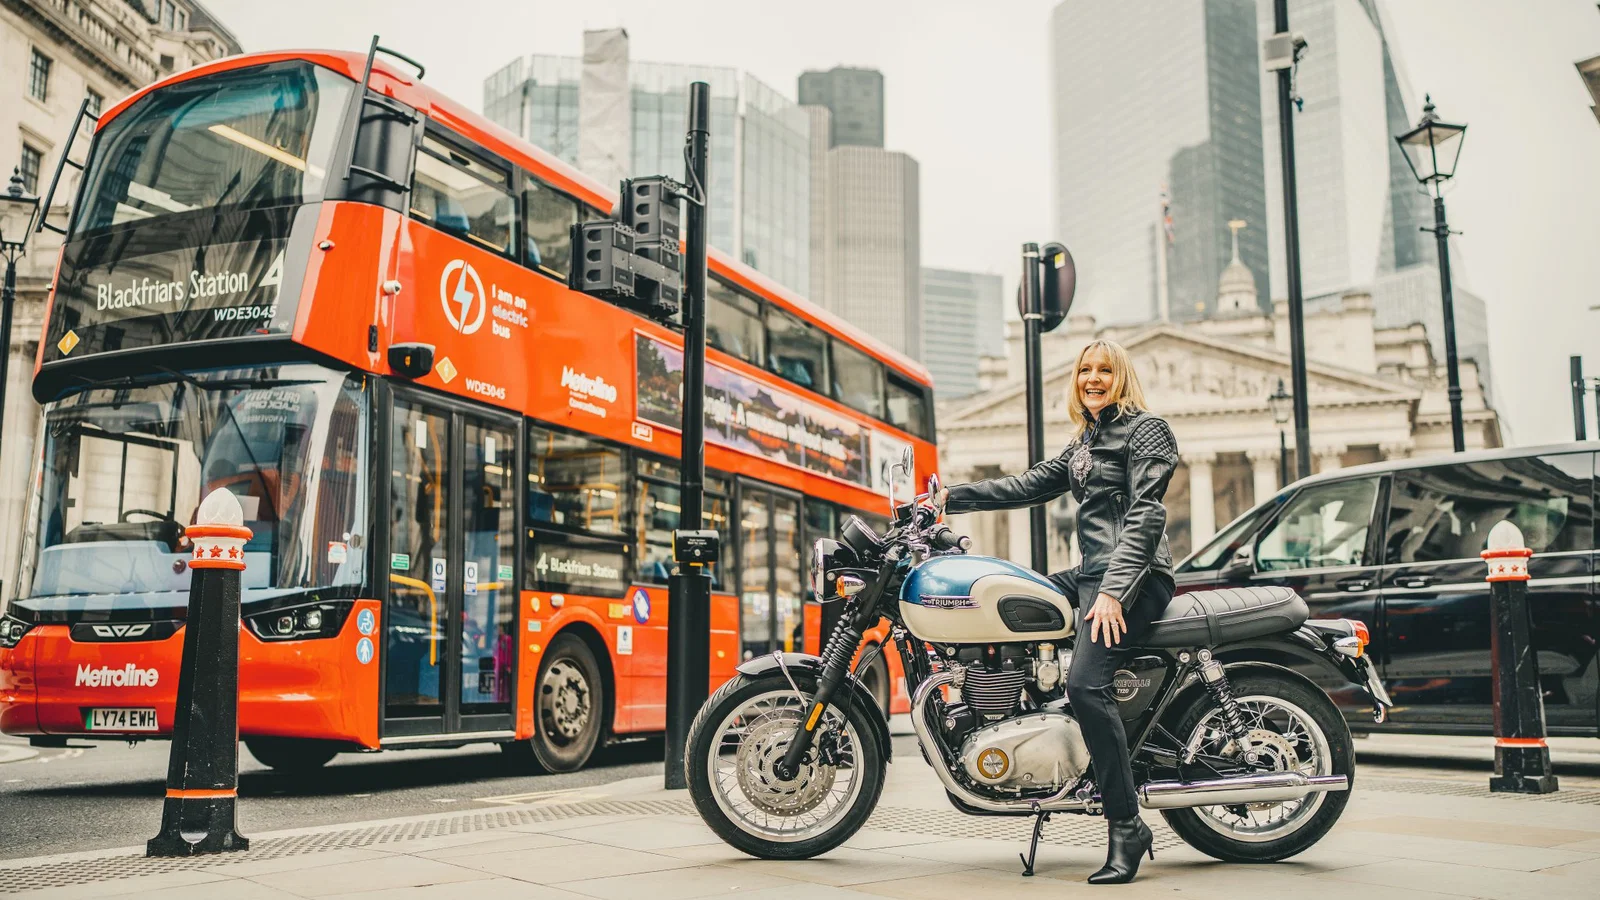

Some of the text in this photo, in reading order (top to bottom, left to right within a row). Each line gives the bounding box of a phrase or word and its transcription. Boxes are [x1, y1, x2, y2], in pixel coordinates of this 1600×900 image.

[97, 249, 285, 311] Blackfriars Station 4
[492, 283, 527, 310] I am an
[214, 306, 276, 322] WDE3045
[492, 304, 529, 328] electric
[492, 319, 511, 339] bus
[465, 377, 506, 400] WDE3045
[561, 365, 617, 403] Metroline
[536, 552, 549, 575] 4
[550, 557, 592, 577] Blackfriars
[592, 563, 619, 580] Station
[931, 598, 966, 606] TRIUMPH
[75, 662, 159, 688] Metroline
[94, 710, 156, 727] LY74 EWH
